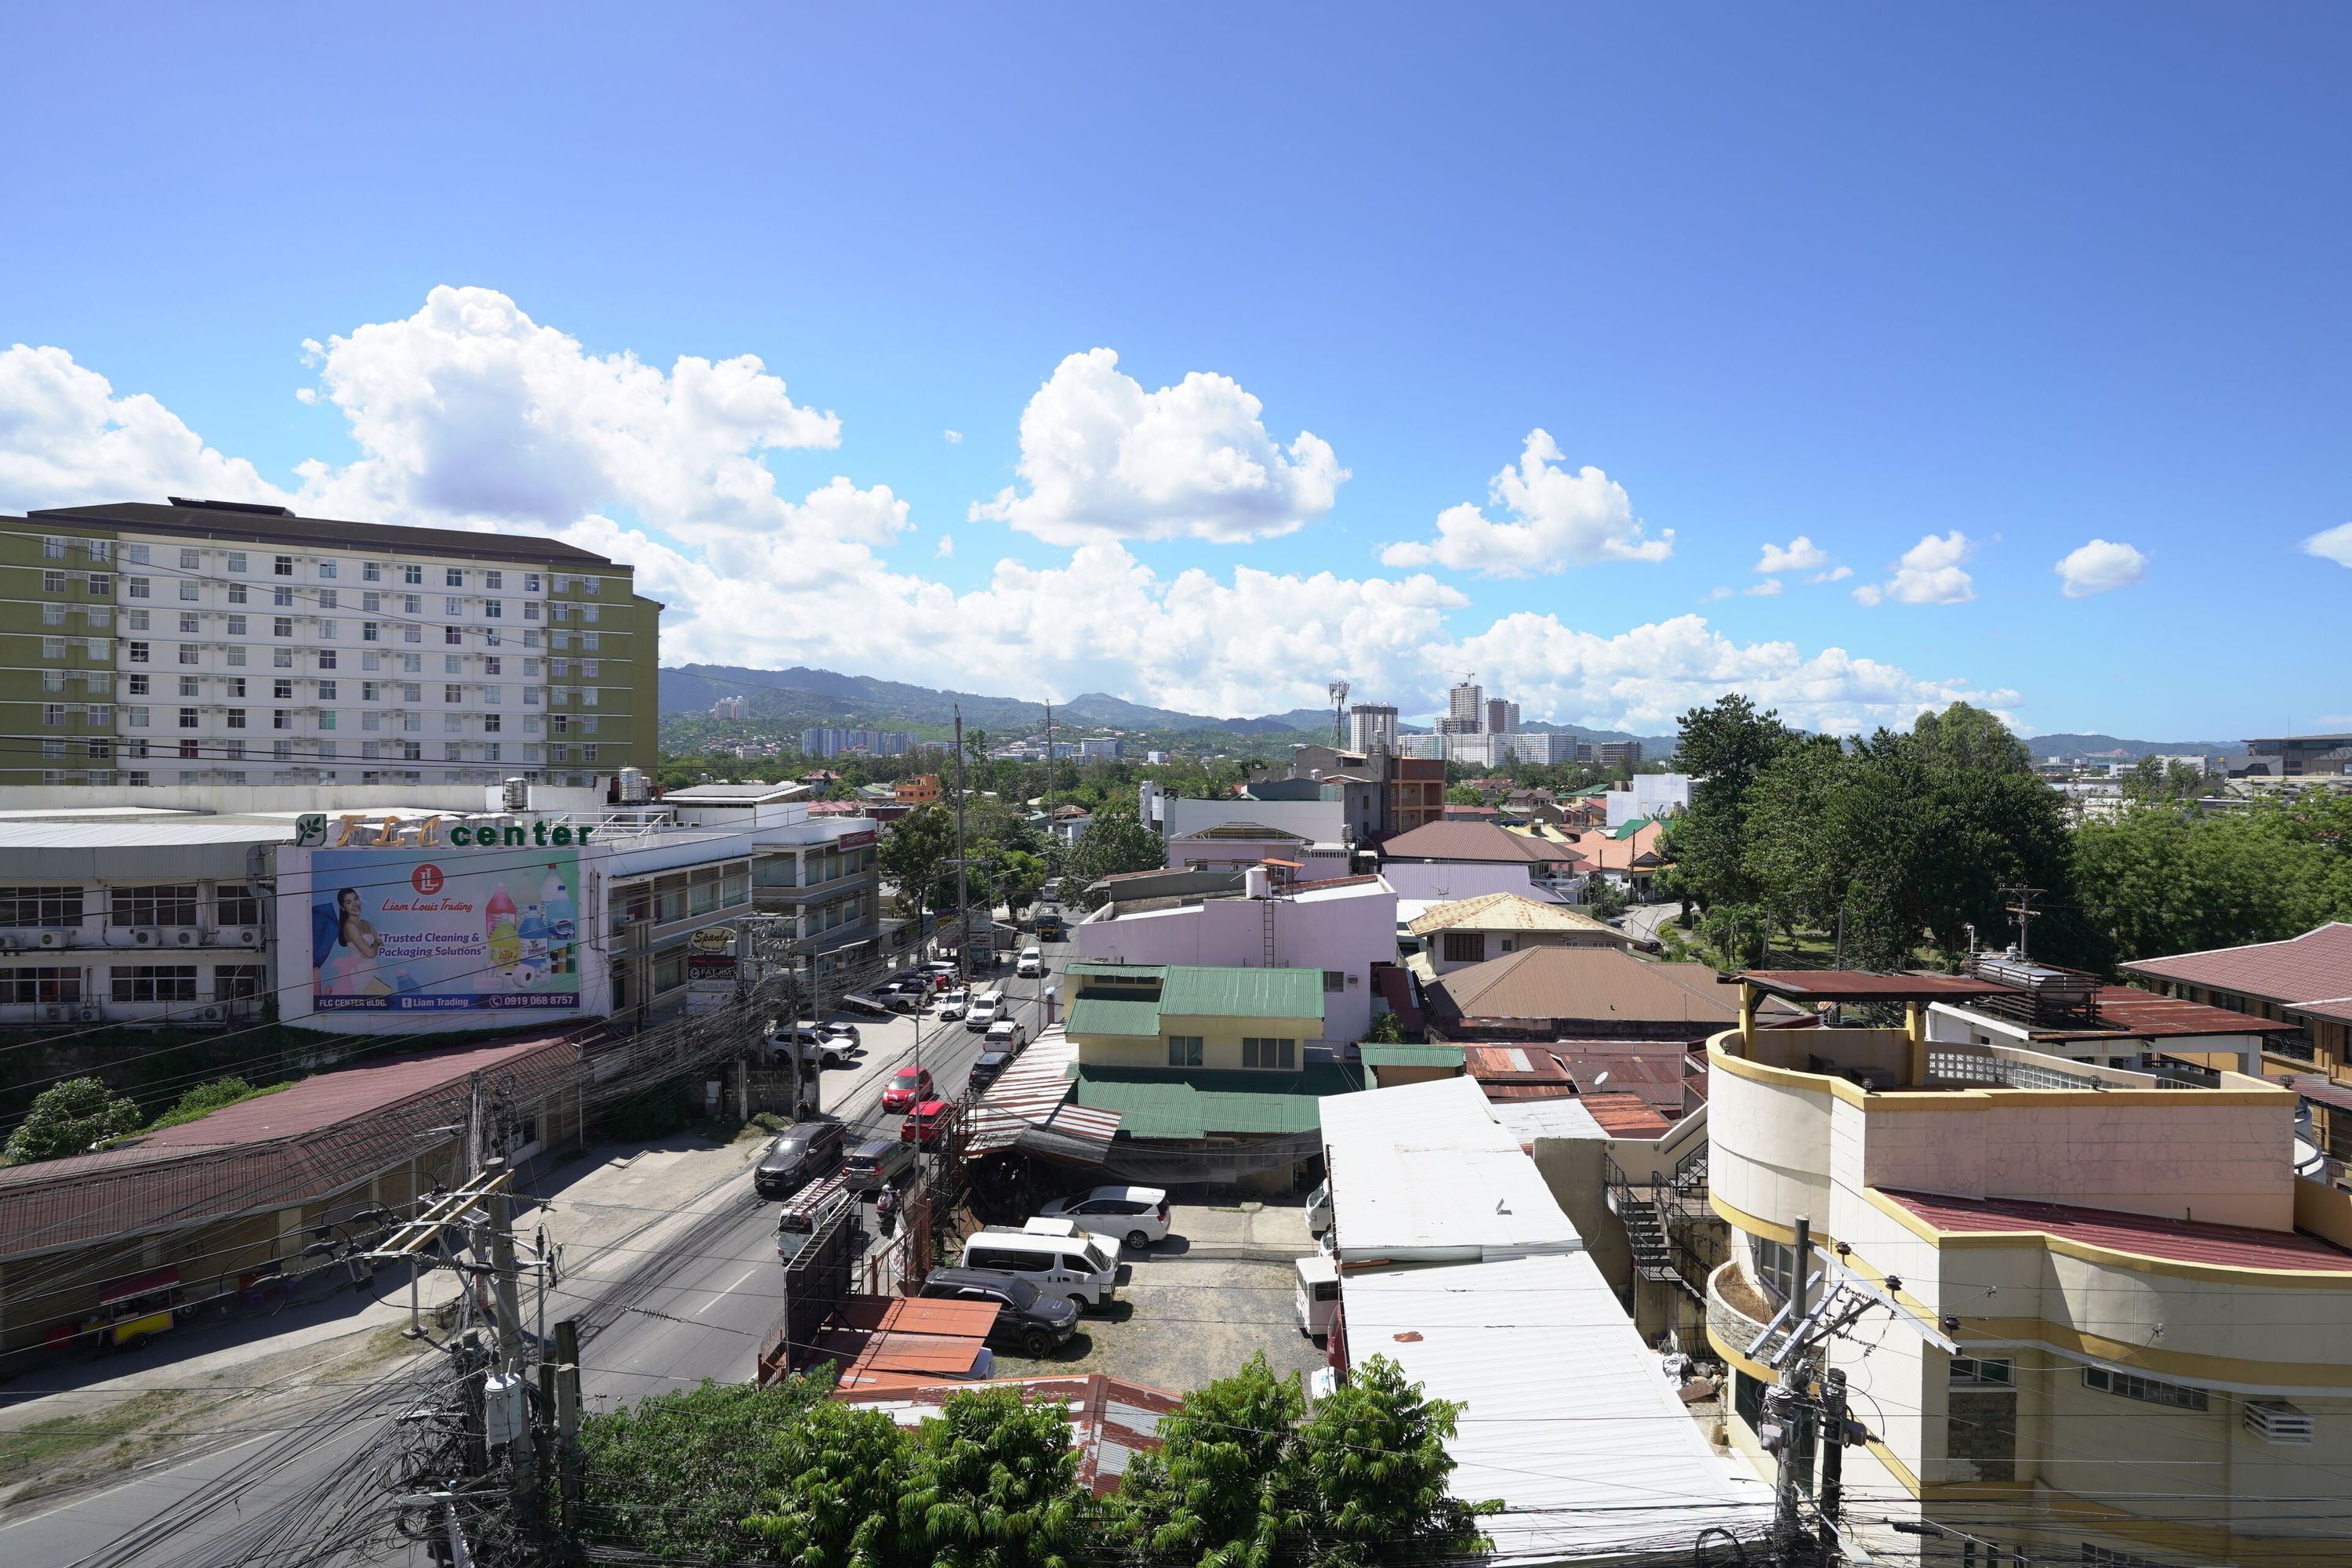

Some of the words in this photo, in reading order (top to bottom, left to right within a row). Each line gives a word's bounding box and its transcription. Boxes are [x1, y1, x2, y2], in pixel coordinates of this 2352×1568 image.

[450, 820, 594, 847] center
[381, 898, 409, 912] Liam
[411, 897, 440, 912] Louis
[440, 898, 474, 913] Trading
[425, 932, 470, 944] Cleaning
[471, 933, 480, 942] &
[379, 946, 433, 957] Packaging
[319, 999, 333, 1007] FLC
[413, 998, 434, 1007] Liam
[437, 998, 469, 1007] Trading
[504, 996, 528, 1005] 0919
[530, 996, 548, 1005] 068
[550, 996, 573, 1004] 8757
